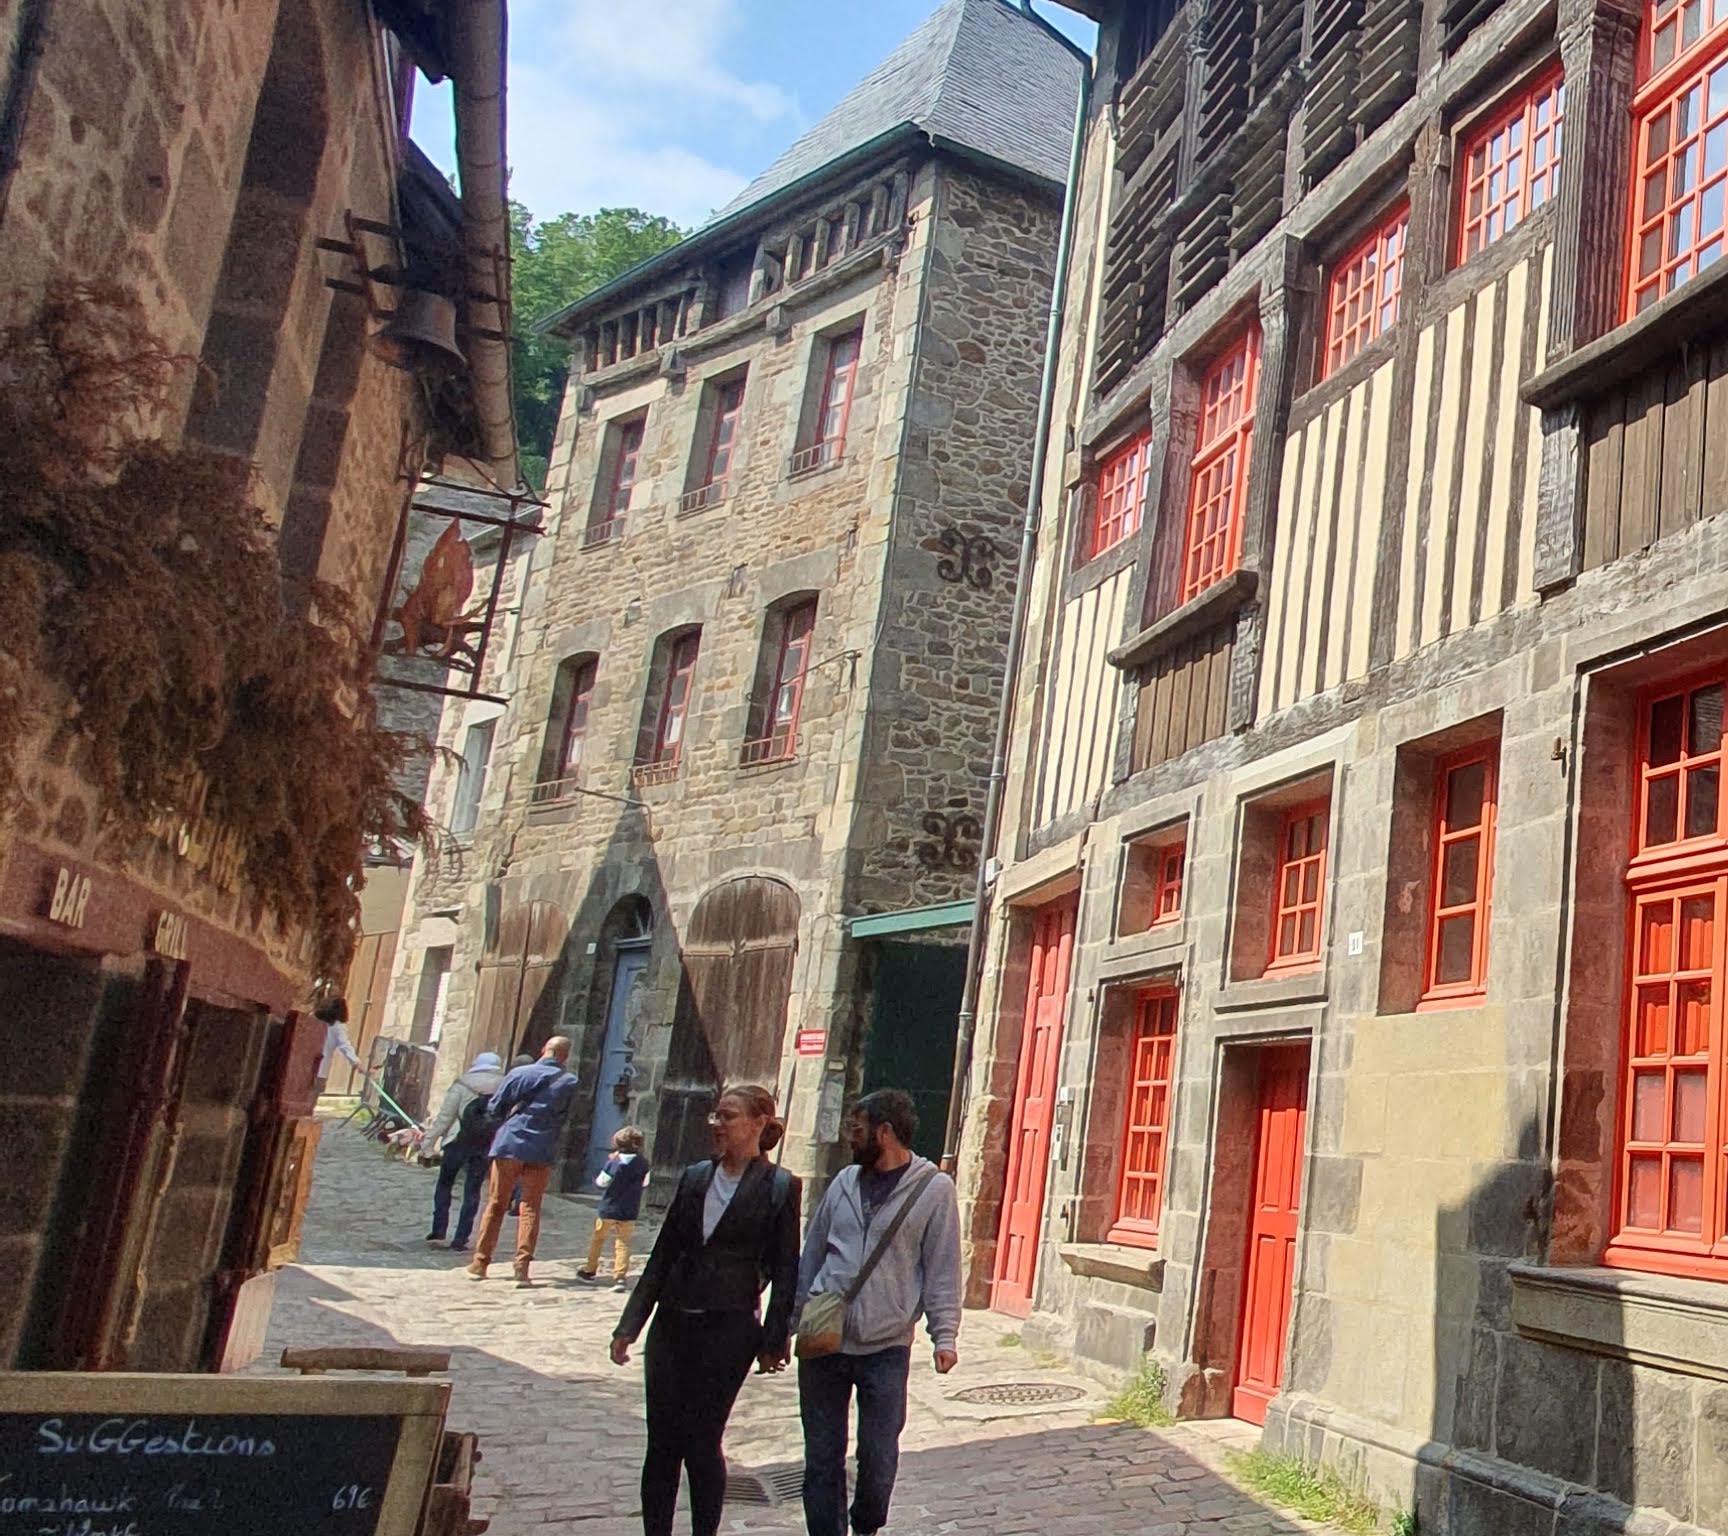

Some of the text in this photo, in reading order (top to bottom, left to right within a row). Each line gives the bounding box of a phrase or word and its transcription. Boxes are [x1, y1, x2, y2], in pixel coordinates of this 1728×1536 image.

[50, 867, 188, 960] BAR GRILL
[0, 1474, 138, 1513] omahawk
